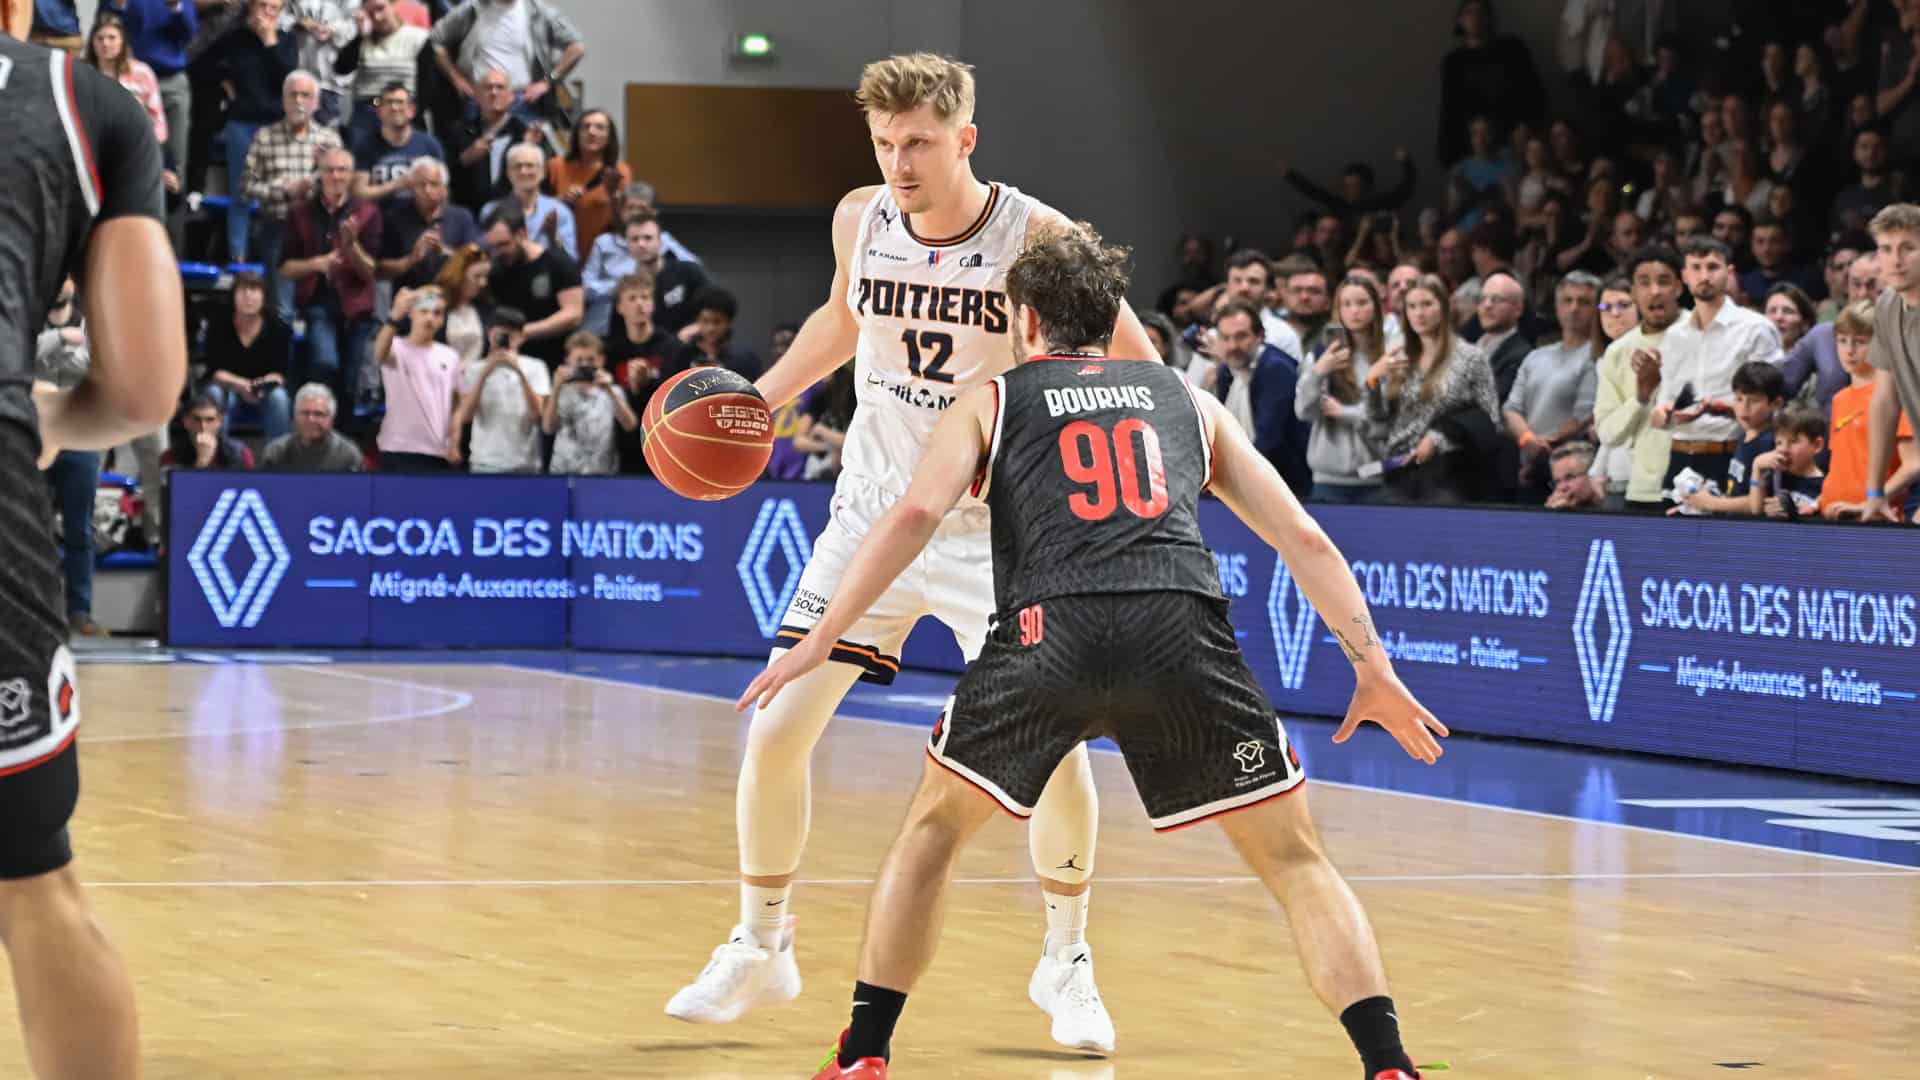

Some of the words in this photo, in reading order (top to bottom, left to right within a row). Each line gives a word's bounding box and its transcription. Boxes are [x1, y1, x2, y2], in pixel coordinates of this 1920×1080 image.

[902, 329, 954, 384] 12
[1043, 386, 1155, 417] BOURHIS
[1058, 418, 1169, 521] 90
[309, 515, 462, 556] SACOA
[472, 517, 551, 557] DES
[561, 519, 704, 561] NATIONS
[593, 573, 664, 602] Poitiers
[794, 598, 826, 616] SOLA
[800, 589, 829, 605] TECHN
[1404, 563, 1447, 610] DES
[1450, 566, 1549, 617] NATIONS
[1019, 604, 1044, 646] 90
[1641, 577, 1733, 632] SACOA
[1740, 583, 1790, 637] DES
[1798, 588, 1917, 647] NATIONS
[1470, 636, 1520, 671] Poitiers
[1677, 655, 1806, 697] Migné-Auxances
[1821, 667, 1882, 705] Poitiers
